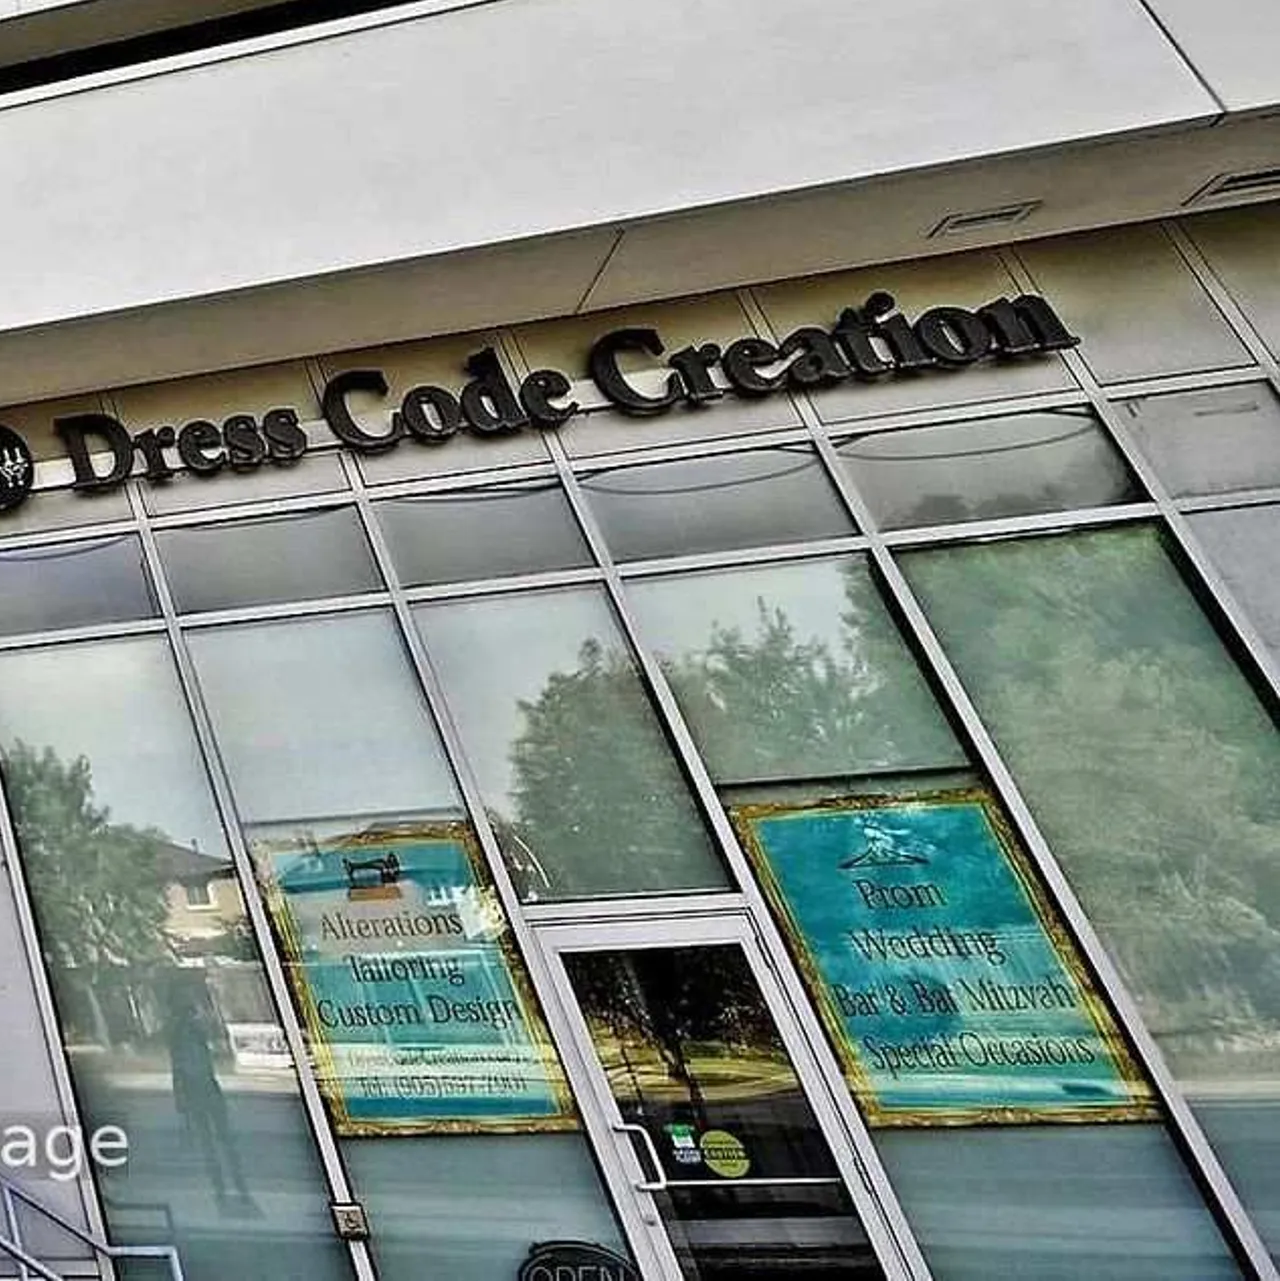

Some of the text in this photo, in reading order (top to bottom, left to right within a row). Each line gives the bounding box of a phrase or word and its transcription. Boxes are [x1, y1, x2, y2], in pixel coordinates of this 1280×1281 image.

[53, 290, 1081, 493] Dress Code Creation
[852, 879, 948, 910] Prom
[321, 910, 464, 941] Alterations
[849, 926, 1007, 966] Wedding
[317, 994, 524, 1030] Custom Design
[832, 983, 880, 1018] Bar
[884, 984, 908, 1016] &
[957, 974, 1077, 1013] Mitzvah
[862, 1030, 1096, 1080] Special Occasions
